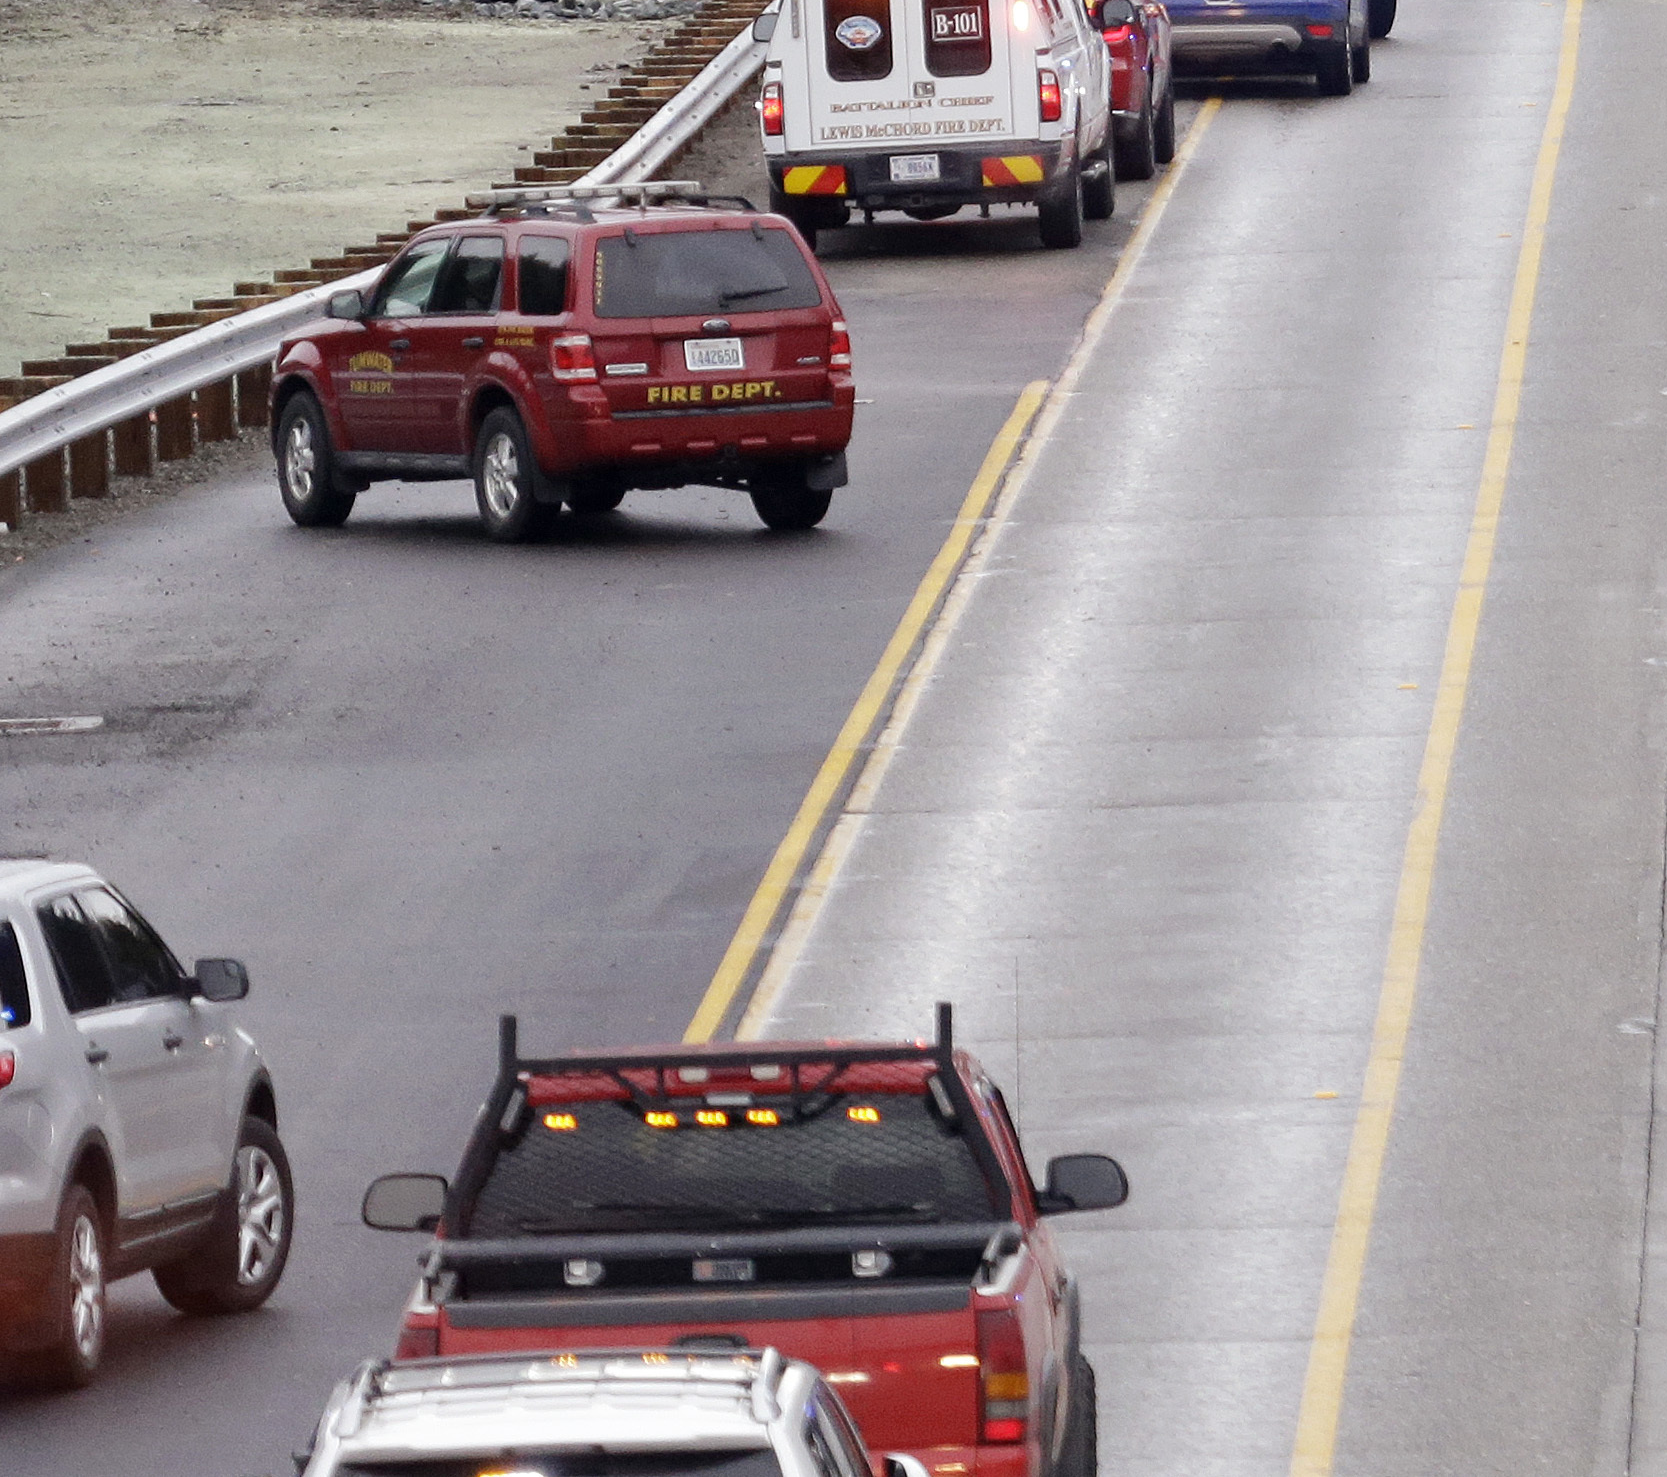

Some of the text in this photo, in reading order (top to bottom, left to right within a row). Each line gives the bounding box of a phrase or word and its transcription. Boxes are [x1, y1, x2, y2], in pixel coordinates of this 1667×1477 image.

[935, 12, 978, 35] B-101
[820, 125, 863, 140] LEWIS
[934, 121, 965, 135] FIRE
[647, 380, 782, 404] FIRE DEPT.
